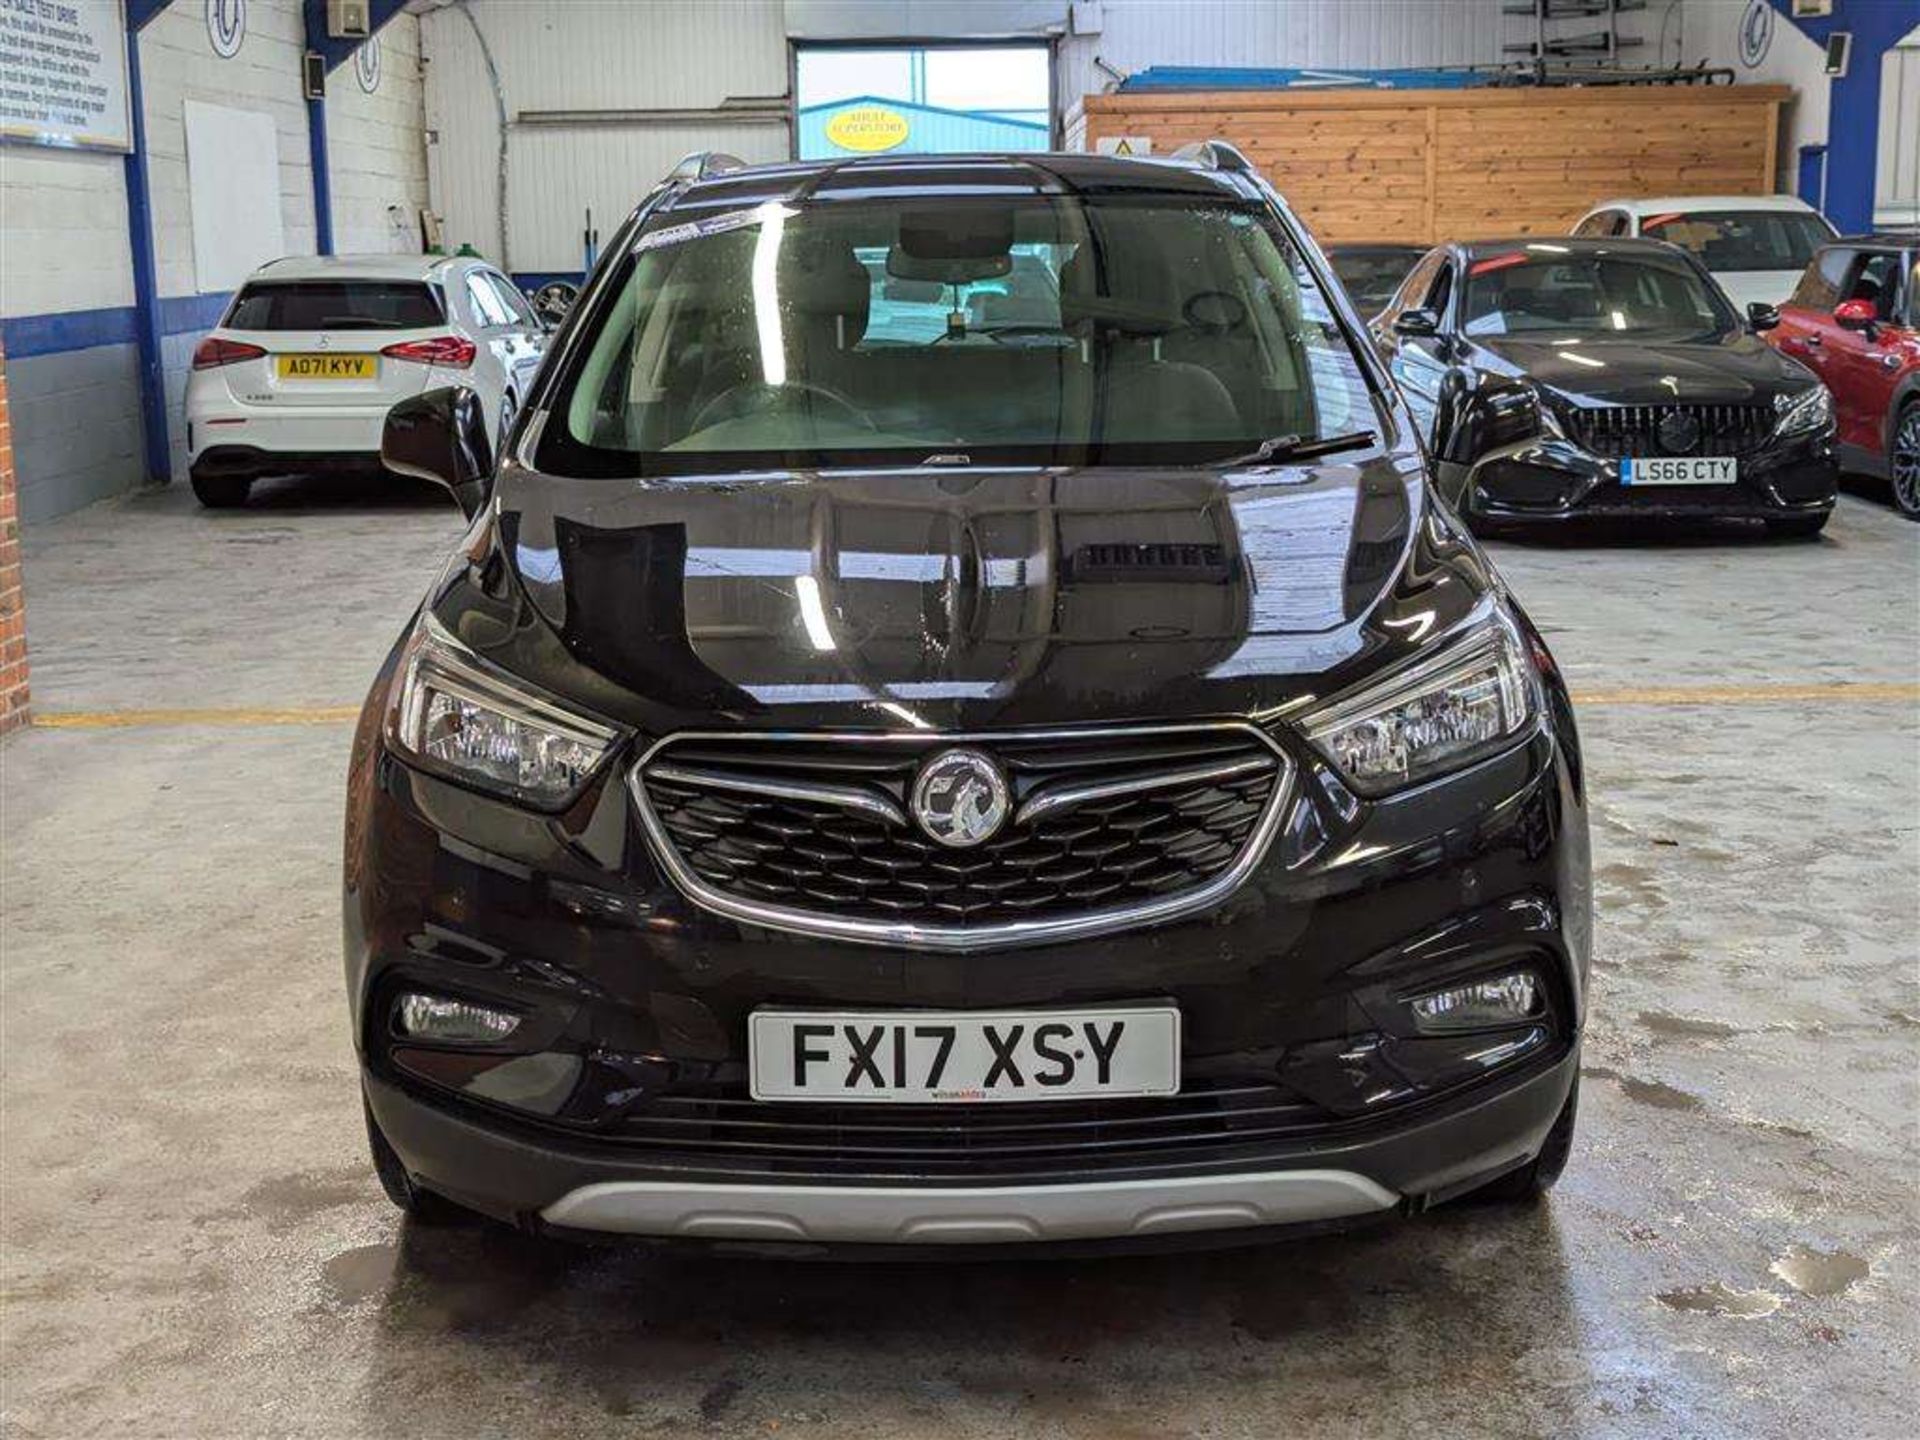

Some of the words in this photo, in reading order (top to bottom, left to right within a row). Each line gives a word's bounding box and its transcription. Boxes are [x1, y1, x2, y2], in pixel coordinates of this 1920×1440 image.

[37, 0, 55, 19] TEST
[56, 4, 79, 26] DRIVE
[329, 358, 364, 374] KYV
[1635, 461, 1688, 481] LS66
[1693, 460, 1734, 479] CTY
[793, 1024, 957, 1089] FX17
[982, 1021, 1126, 1089] XSY
